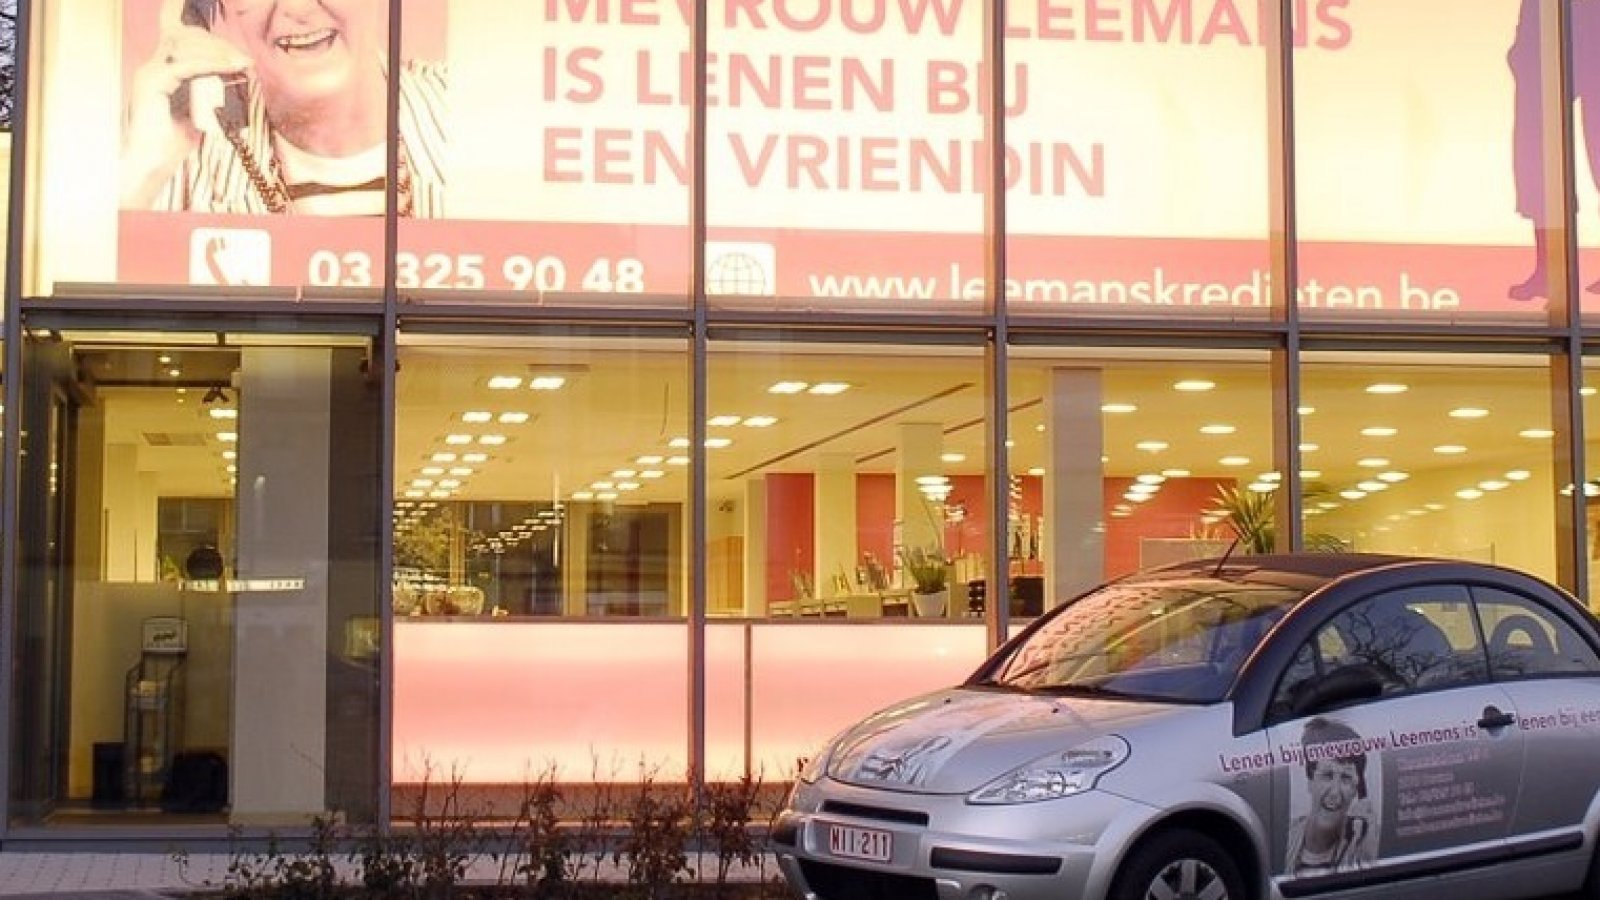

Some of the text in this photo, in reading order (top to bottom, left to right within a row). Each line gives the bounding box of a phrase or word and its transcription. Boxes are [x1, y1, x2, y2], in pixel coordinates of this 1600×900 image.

[543, 46, 1029, 118] IS LENEN BIJ
[543, 127, 1105, 197] EEN VRIENDIN
[308, 249, 645, 294] 03 325 90 48
